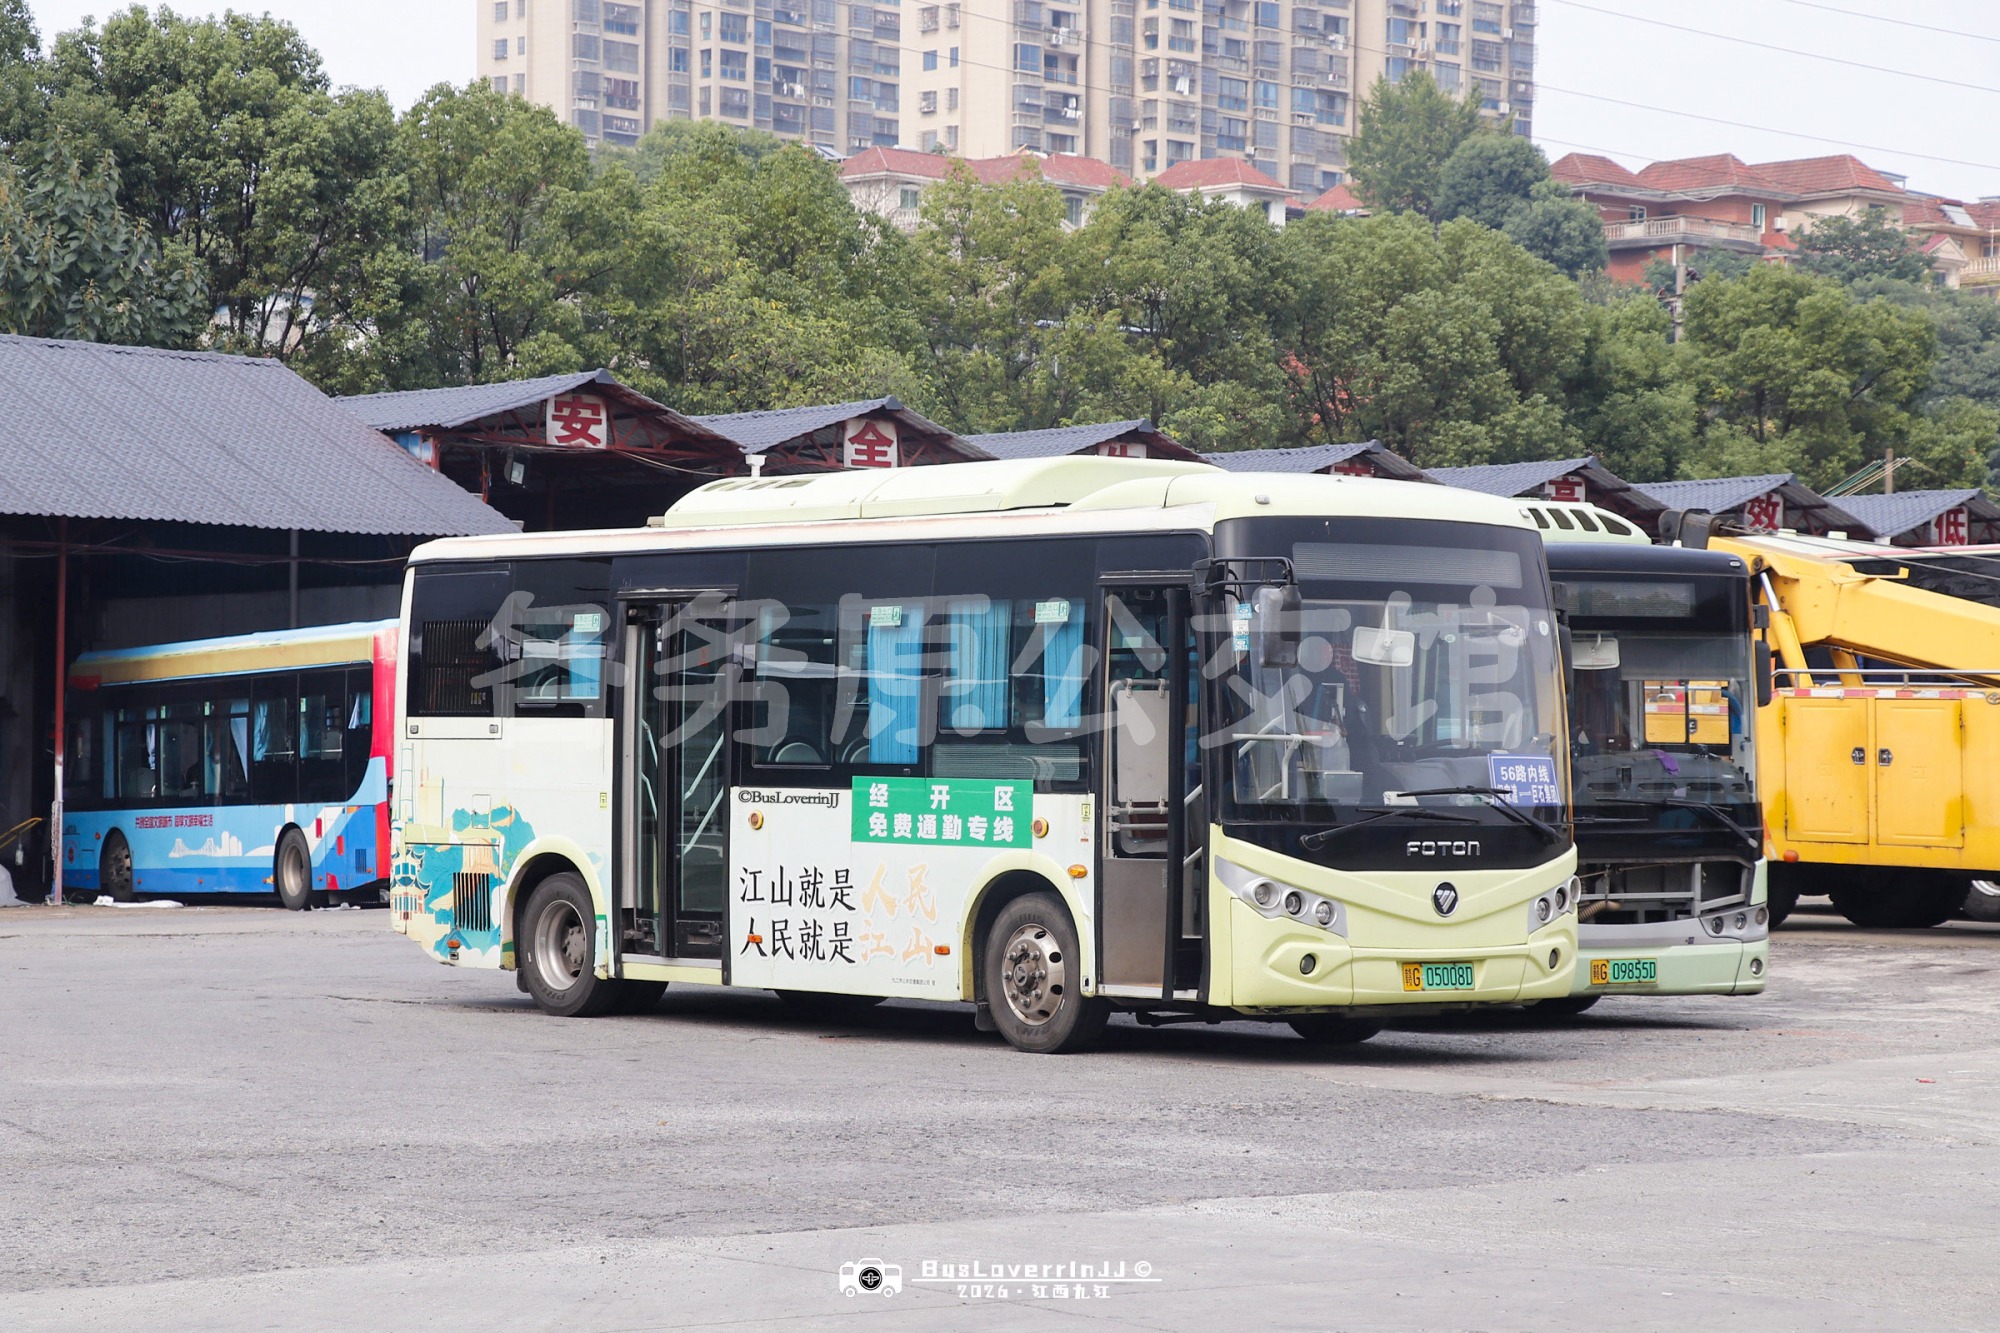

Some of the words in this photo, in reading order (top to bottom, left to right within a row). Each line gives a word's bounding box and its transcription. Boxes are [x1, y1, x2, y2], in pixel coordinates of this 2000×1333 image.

[552, 396, 603, 446] 安
[849, 421, 894, 468] 全
[1747, 495, 1780, 531] 效
[1935, 508, 1968, 546] 低
[1501, 765, 1550, 783] 56路内线
[869, 783, 1014, 812] 经开区
[869, 812, 1014, 843] 免费通勤专线
[1406, 841, 1481, 856] FOTON
[739, 863, 938, 921] 江山就是人民
[740, 917, 935, 966] 人民就是江山
